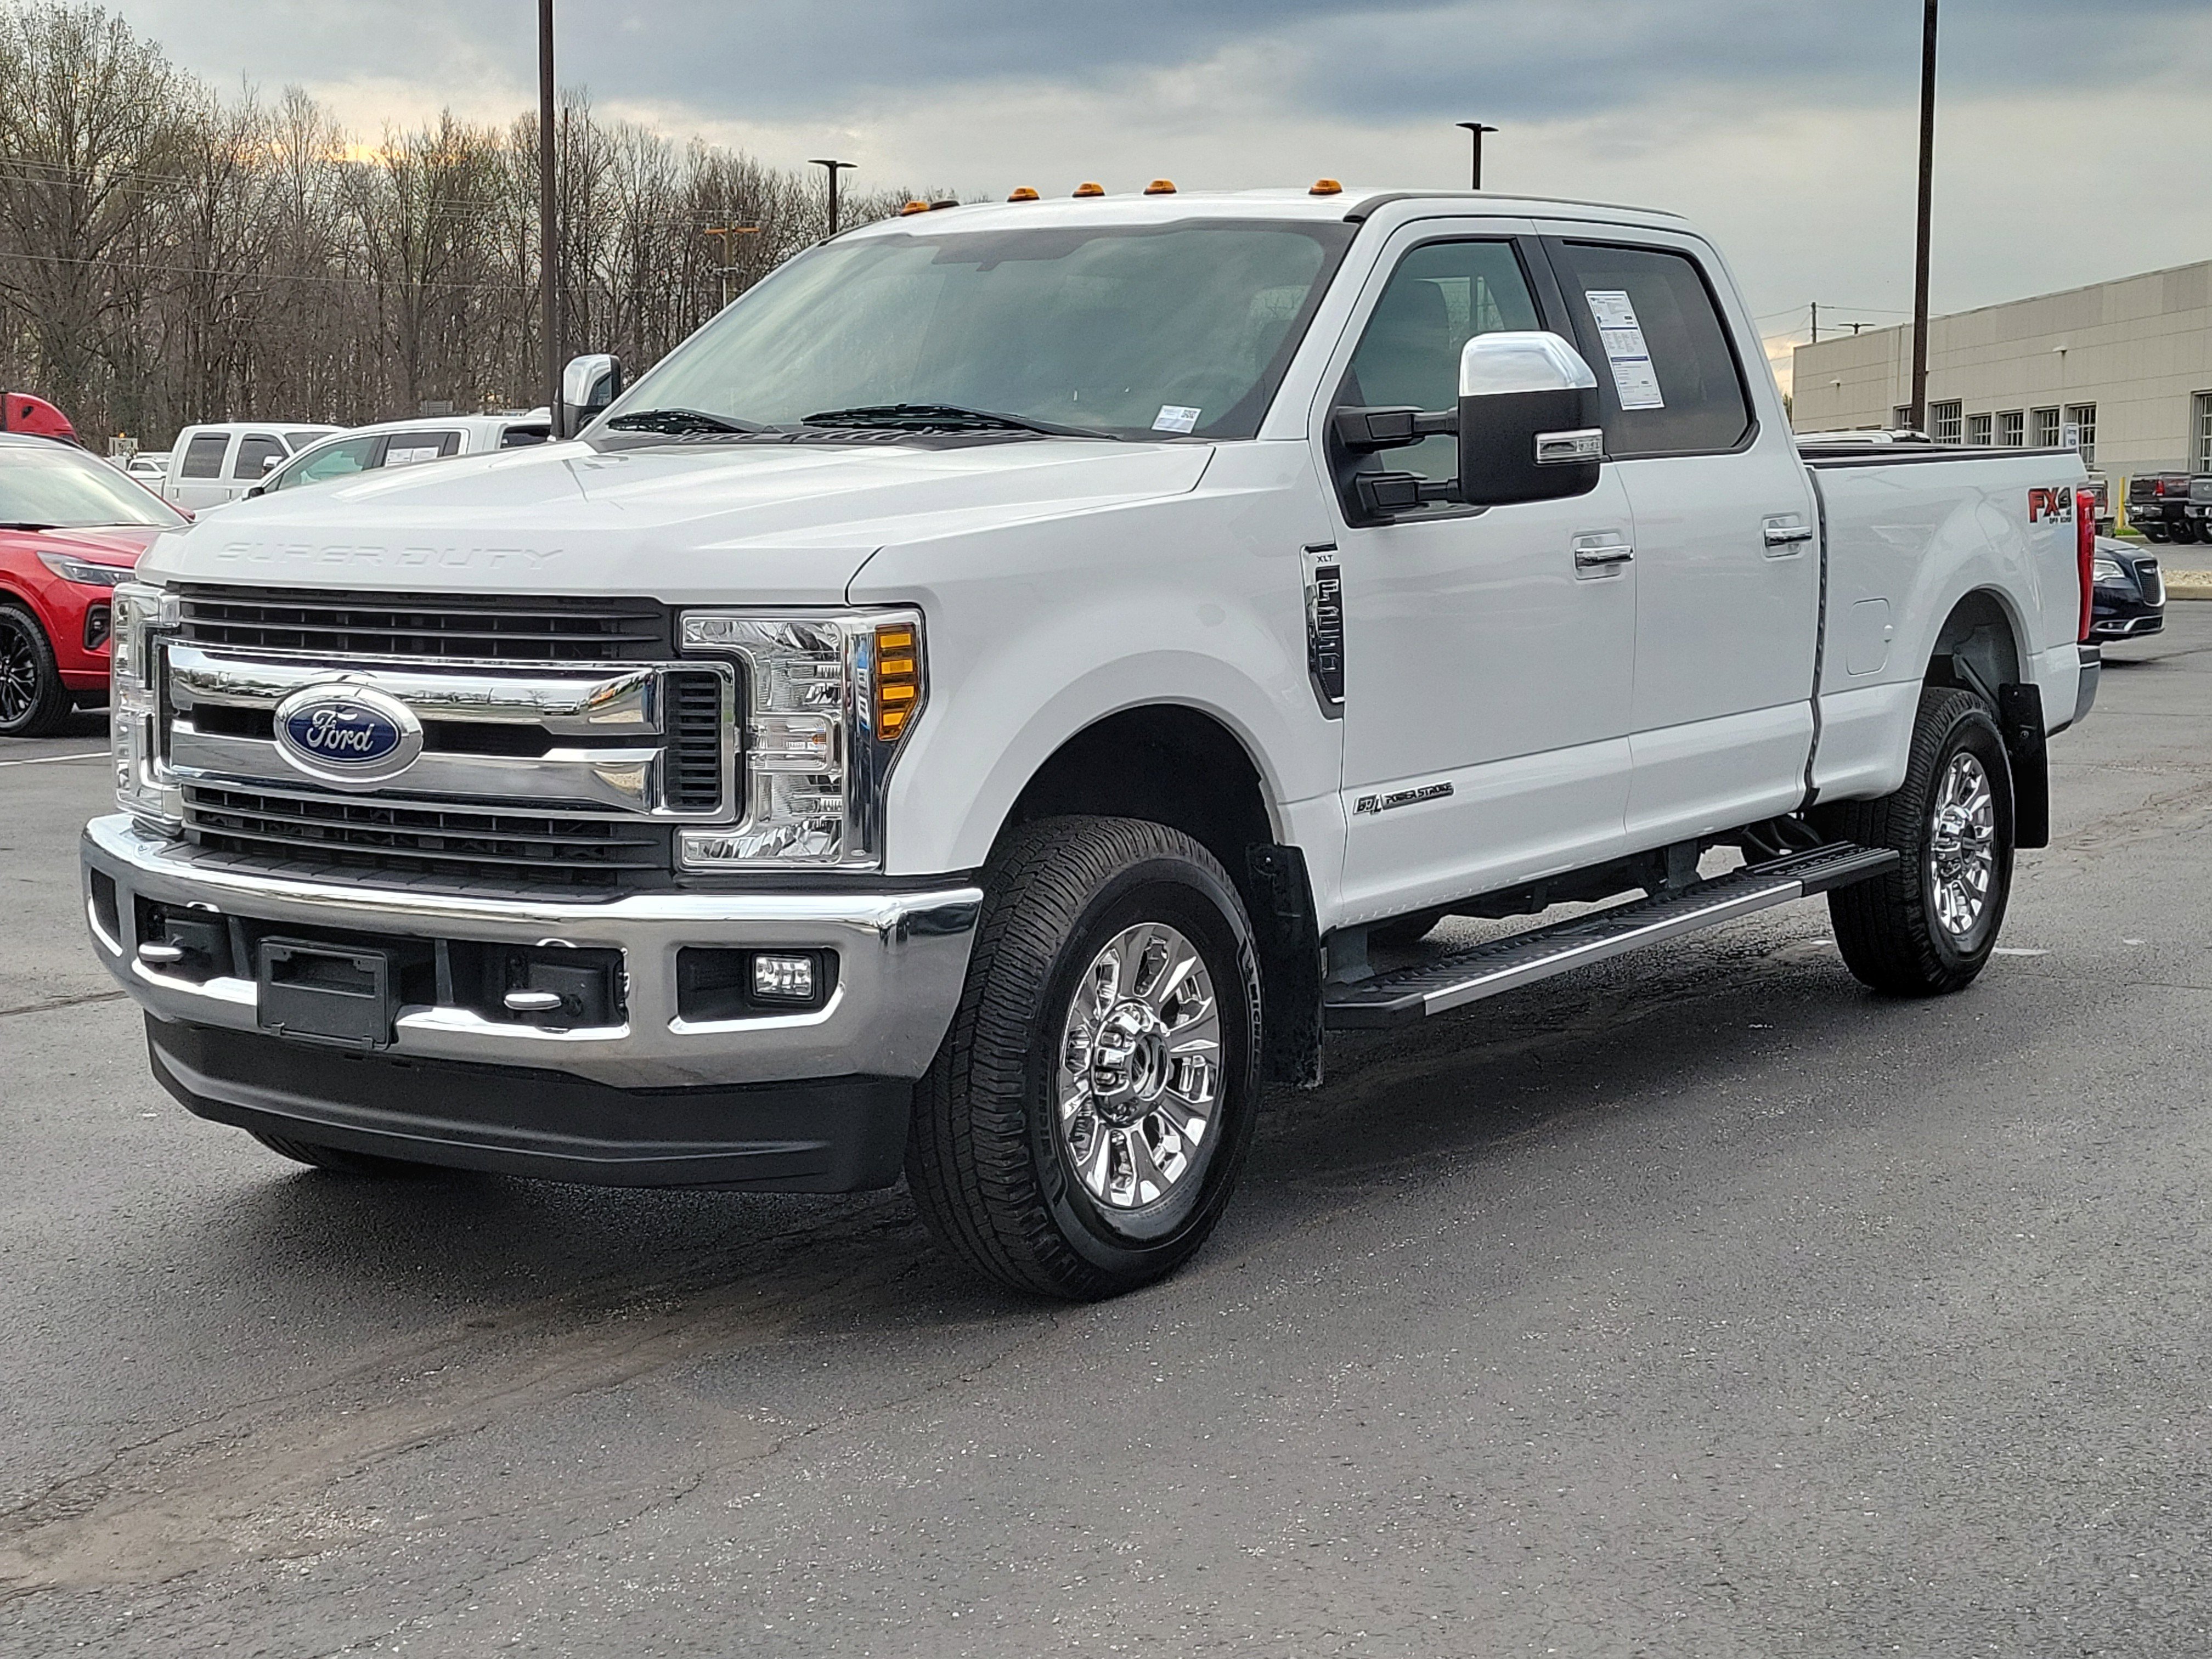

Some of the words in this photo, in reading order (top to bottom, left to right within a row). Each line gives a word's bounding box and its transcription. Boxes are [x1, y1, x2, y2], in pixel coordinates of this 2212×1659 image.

[2028, 487, 2072, 523] FX4
[216, 541, 387, 566] SUPER
[396, 547, 563, 569] DUTY
[1316, 555, 1333, 563] XLT
[306, 709, 375, 752] Ford
